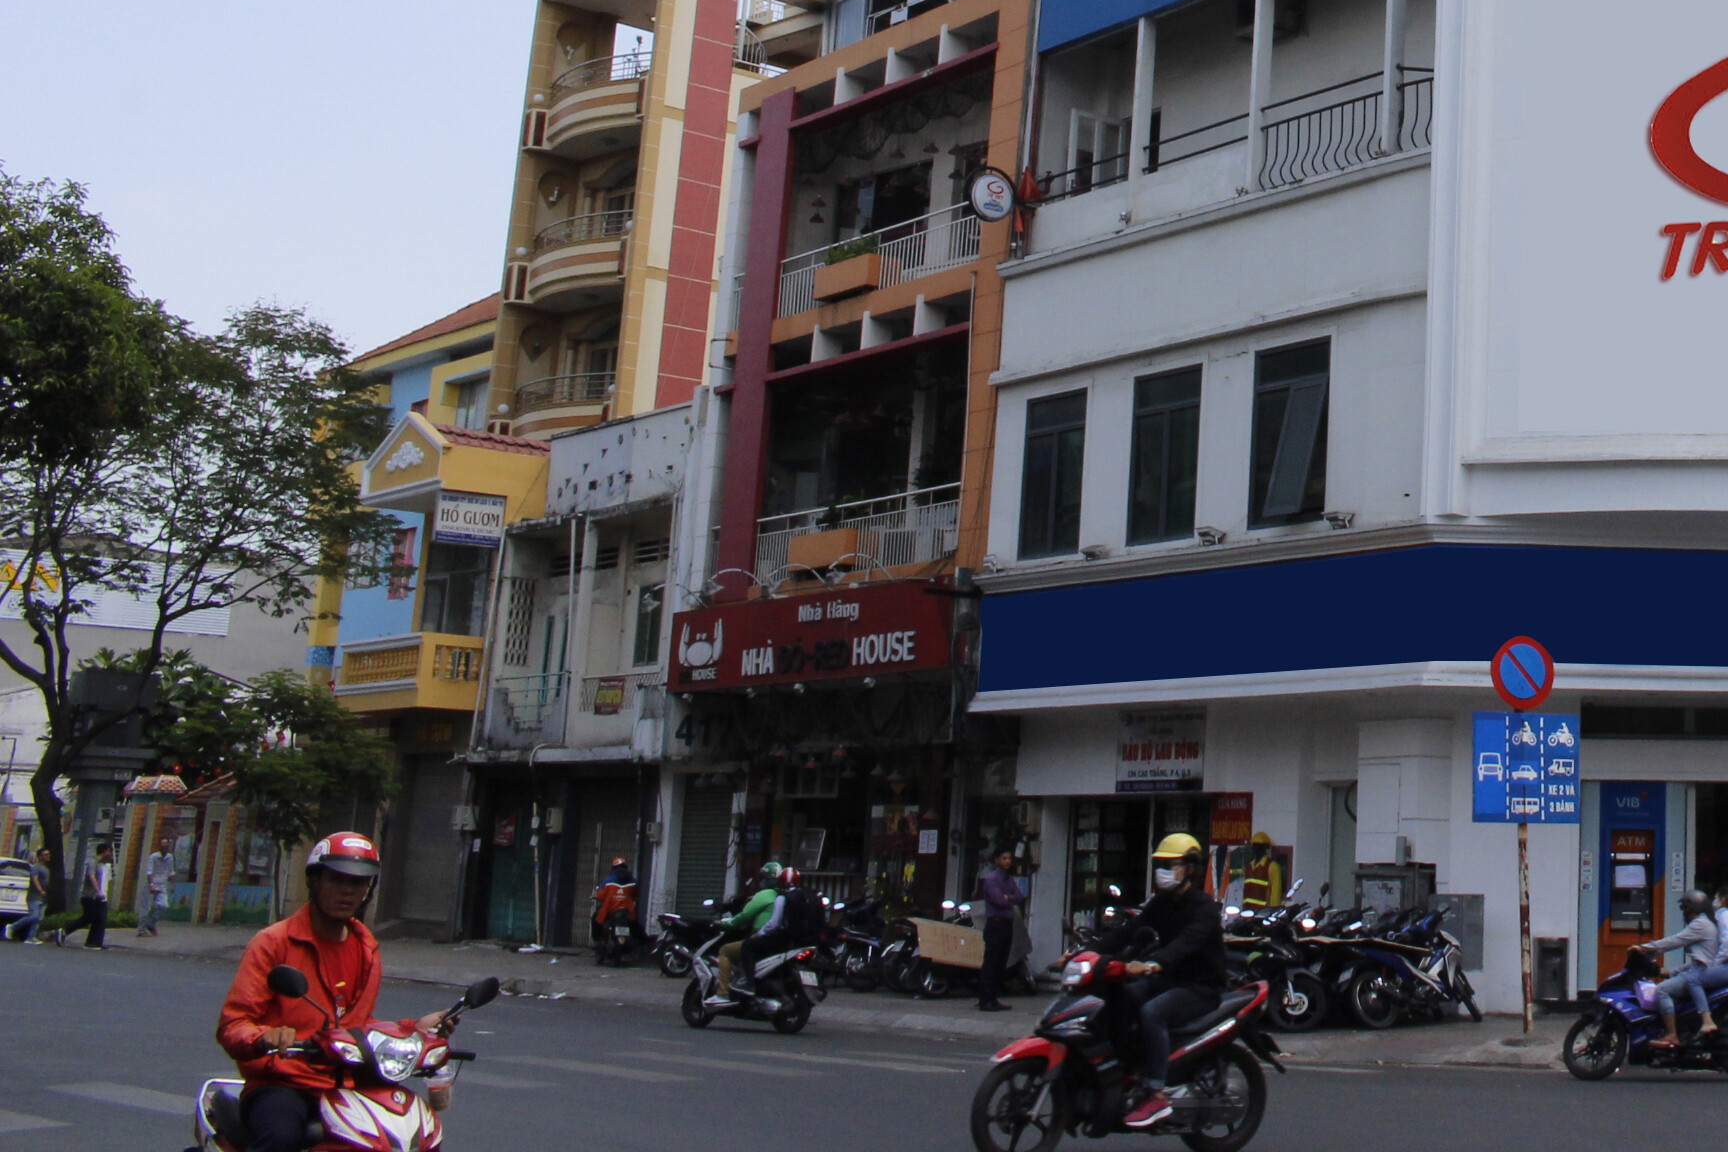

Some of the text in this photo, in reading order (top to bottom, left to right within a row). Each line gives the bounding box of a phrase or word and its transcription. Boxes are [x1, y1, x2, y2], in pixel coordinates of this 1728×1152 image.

[441, 504, 459, 523] HỒ
[798, 599, 860, 623] Nhà Hàng
[741, 639, 775, 677] NHÀ
[852, 630, 917, 666] HOUSE
[692, 667, 718, 681] HOUSE
[1548, 783, 1575, 796] XE 2 VÀ
[1549, 803, 1555, 813] 3
[1616, 796, 1640, 808] VIB
[1617, 836, 1646, 846] ATM
